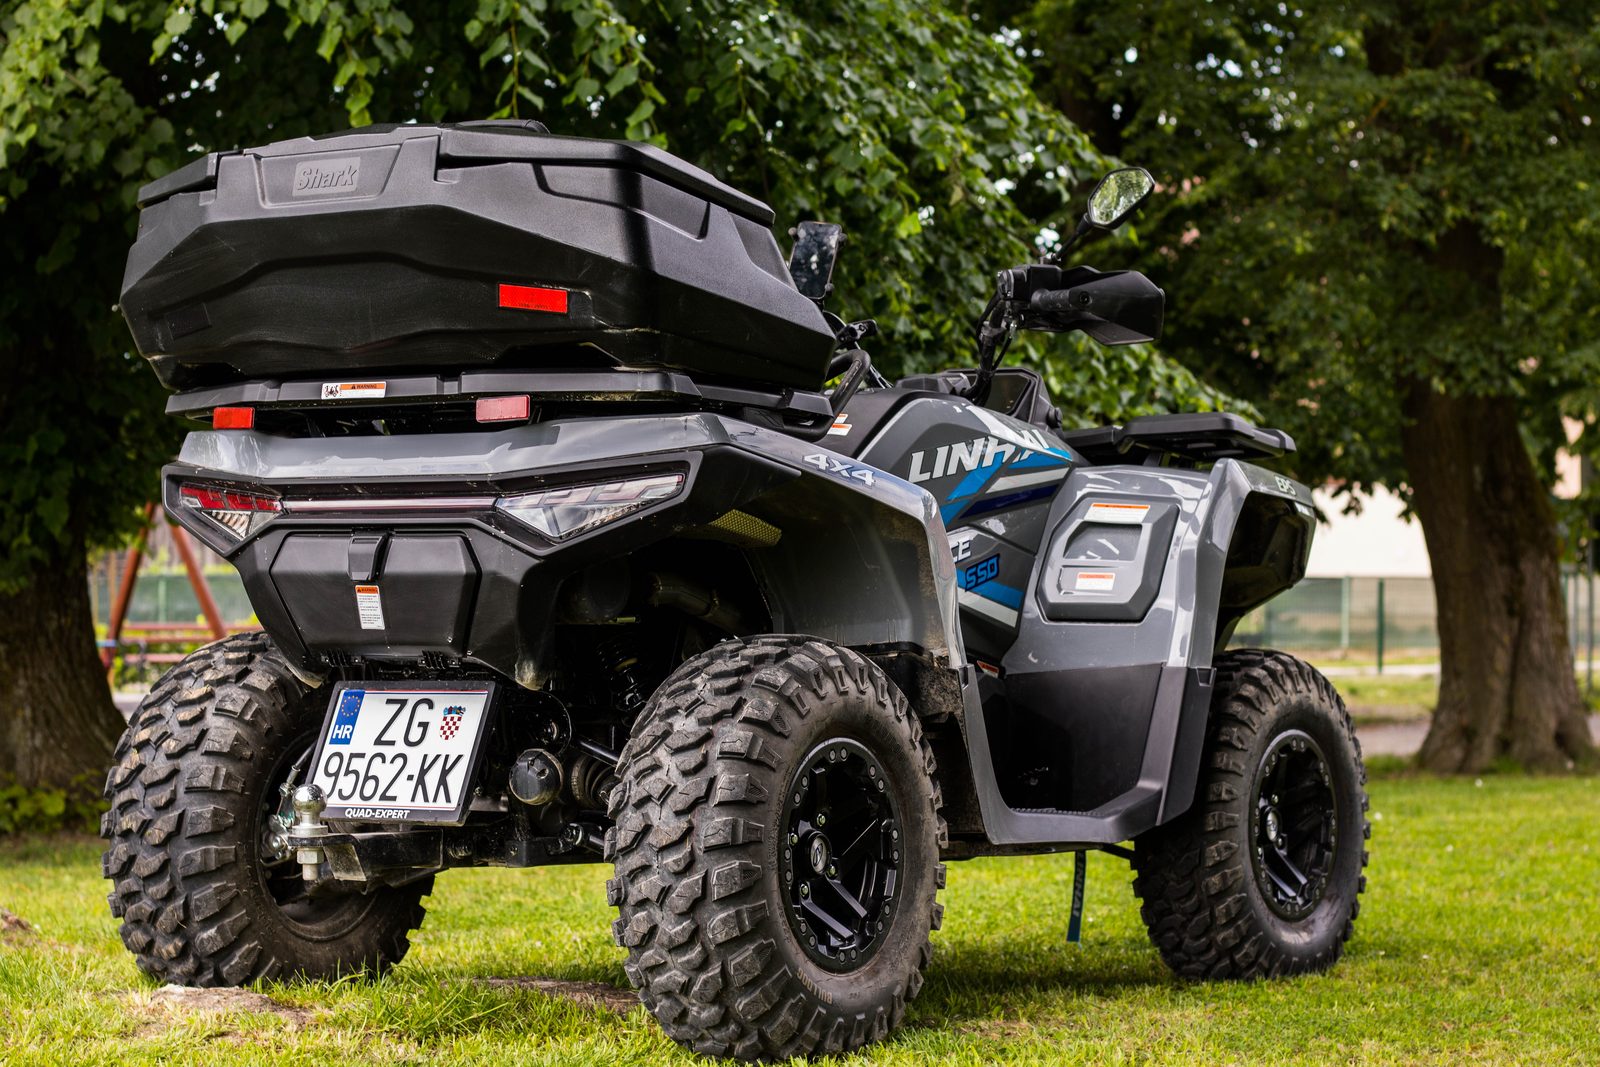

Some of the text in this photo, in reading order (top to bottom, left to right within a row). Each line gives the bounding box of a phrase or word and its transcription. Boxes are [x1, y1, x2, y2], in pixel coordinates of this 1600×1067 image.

[297, 165, 358, 191] Shark
[908, 428, 1050, 484] LINHAI
[1274, 475, 1296, 496] EPS
[965, 553, 999, 590] 550
[332, 724, 353, 740] HR
[372, 698, 434, 747] ZG
[323, 751, 464, 803] 9562-KK
[344, 808, 410, 819] QUAD-EXPERT
[796, 967, 833, 1005] BULLDOG
